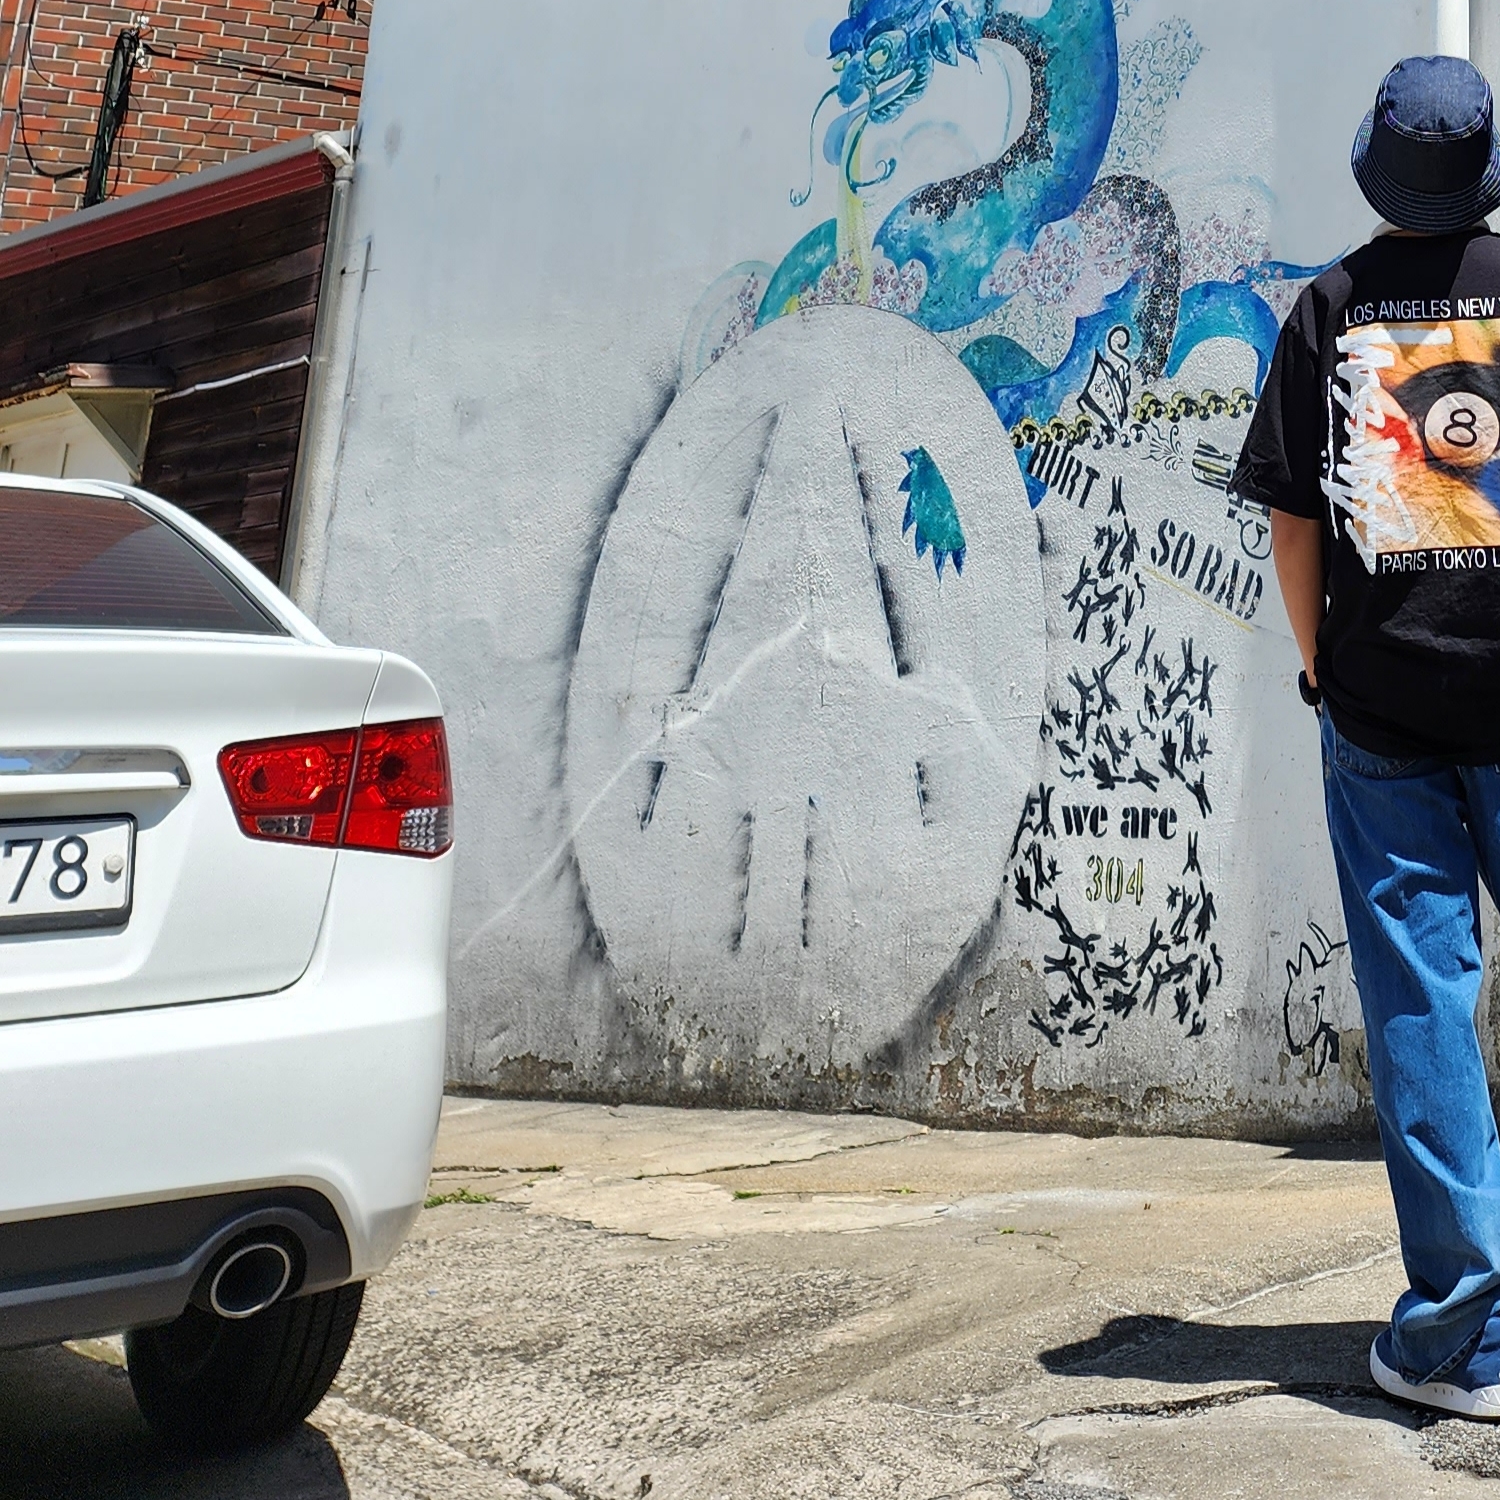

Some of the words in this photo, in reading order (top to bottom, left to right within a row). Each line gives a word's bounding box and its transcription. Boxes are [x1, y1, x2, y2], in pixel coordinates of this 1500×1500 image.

[1345, 303, 1375, 327] LOS
[1378, 300, 1451, 320] ANGELES
[1457, 298, 1496, 318] NEW
[1442, 408, 1477, 447] 8
[1150, 517, 1197, 580] SO
[1194, 543, 1264, 621] BAD
[1381, 552, 1427, 575] PARIS
[1431, 547, 1487, 572] TOKYO
[1060, 804, 1110, 838] we
[1119, 806, 1178, 840] are
[1085, 854, 1144, 906] 304
